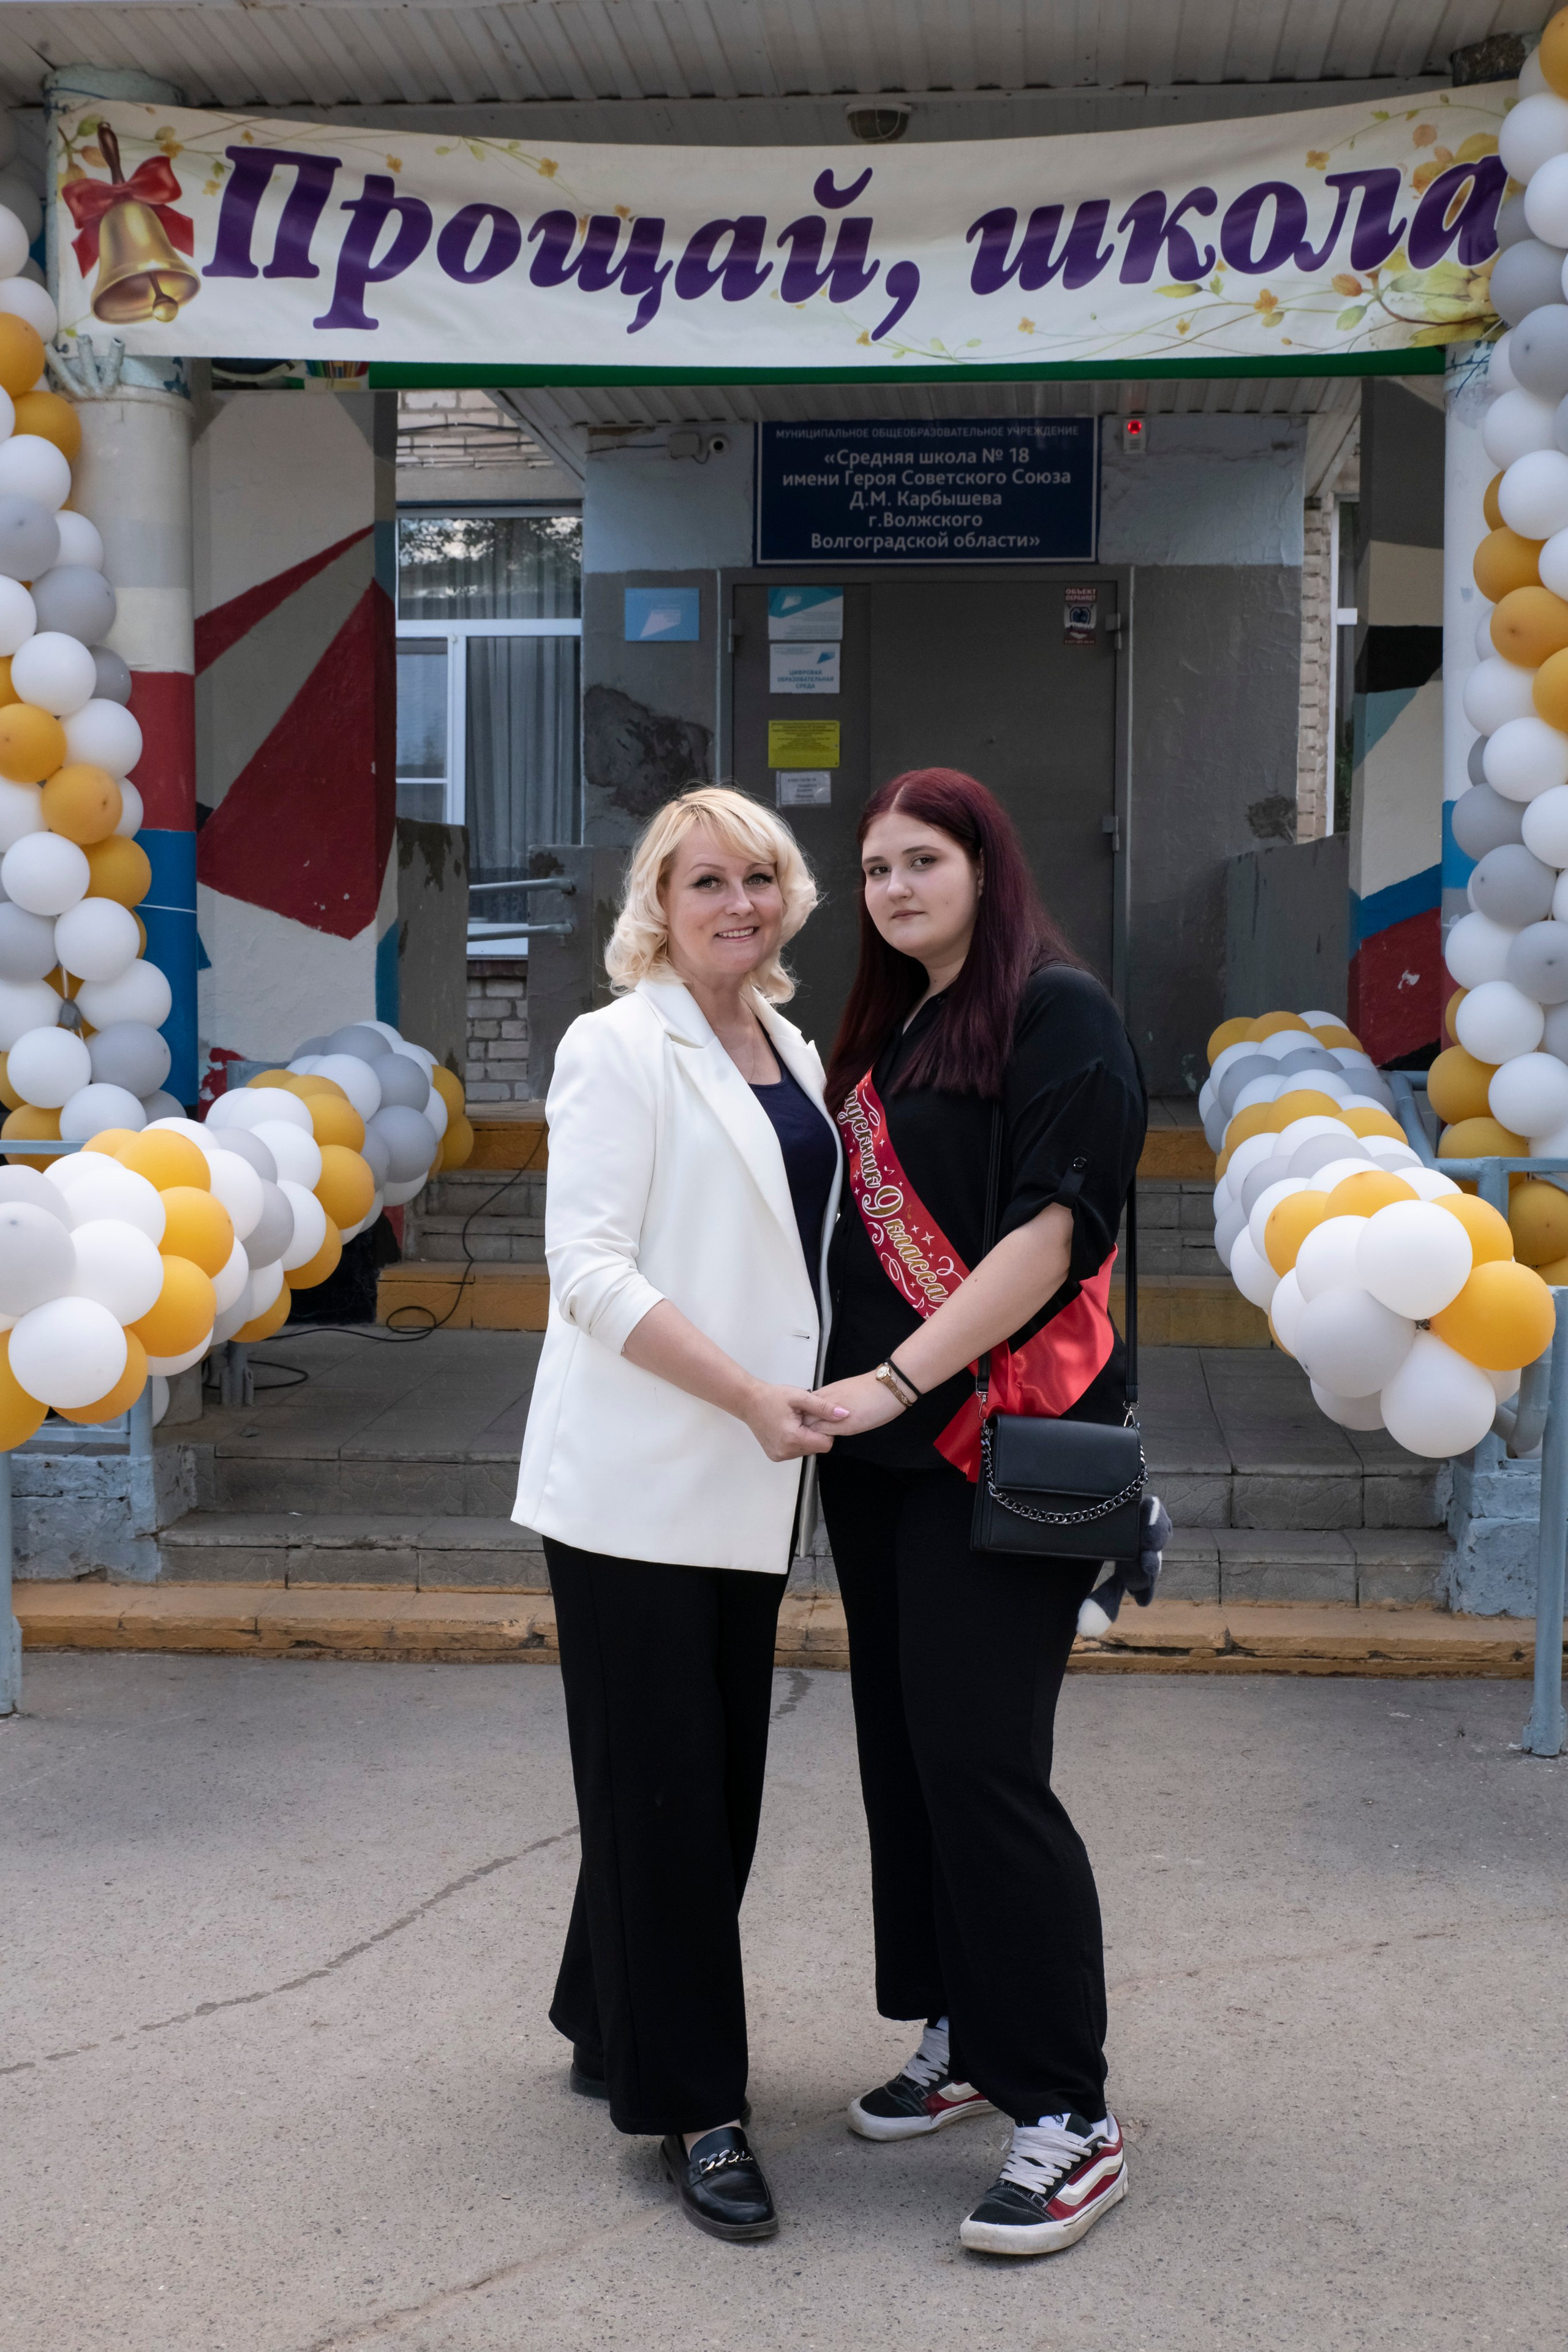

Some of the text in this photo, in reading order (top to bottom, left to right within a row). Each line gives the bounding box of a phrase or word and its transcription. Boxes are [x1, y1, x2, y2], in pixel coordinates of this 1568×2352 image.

[201, 145, 1509, 342] Прощай, школа
[776, 426, 1079, 439] МУНИЦИПАЛЬНОЕ ОБЩЕОБРАЗОВАТЕЛЬНОЕ УЧРЕЖДЕНИЕ
[824, 447, 1030, 469] «Средняя школа № 18
[782, 469, 1072, 489] имени Героя Советского Союза
[849, 491, 1002, 510] Д.М. Карбышева
[869, 512, 983, 527] г.Волжского
[811, 532, 1041, 552] Волгоградской области»
[862, 1185, 903, 1218] 9
[883, 1218, 949, 1303] класса
